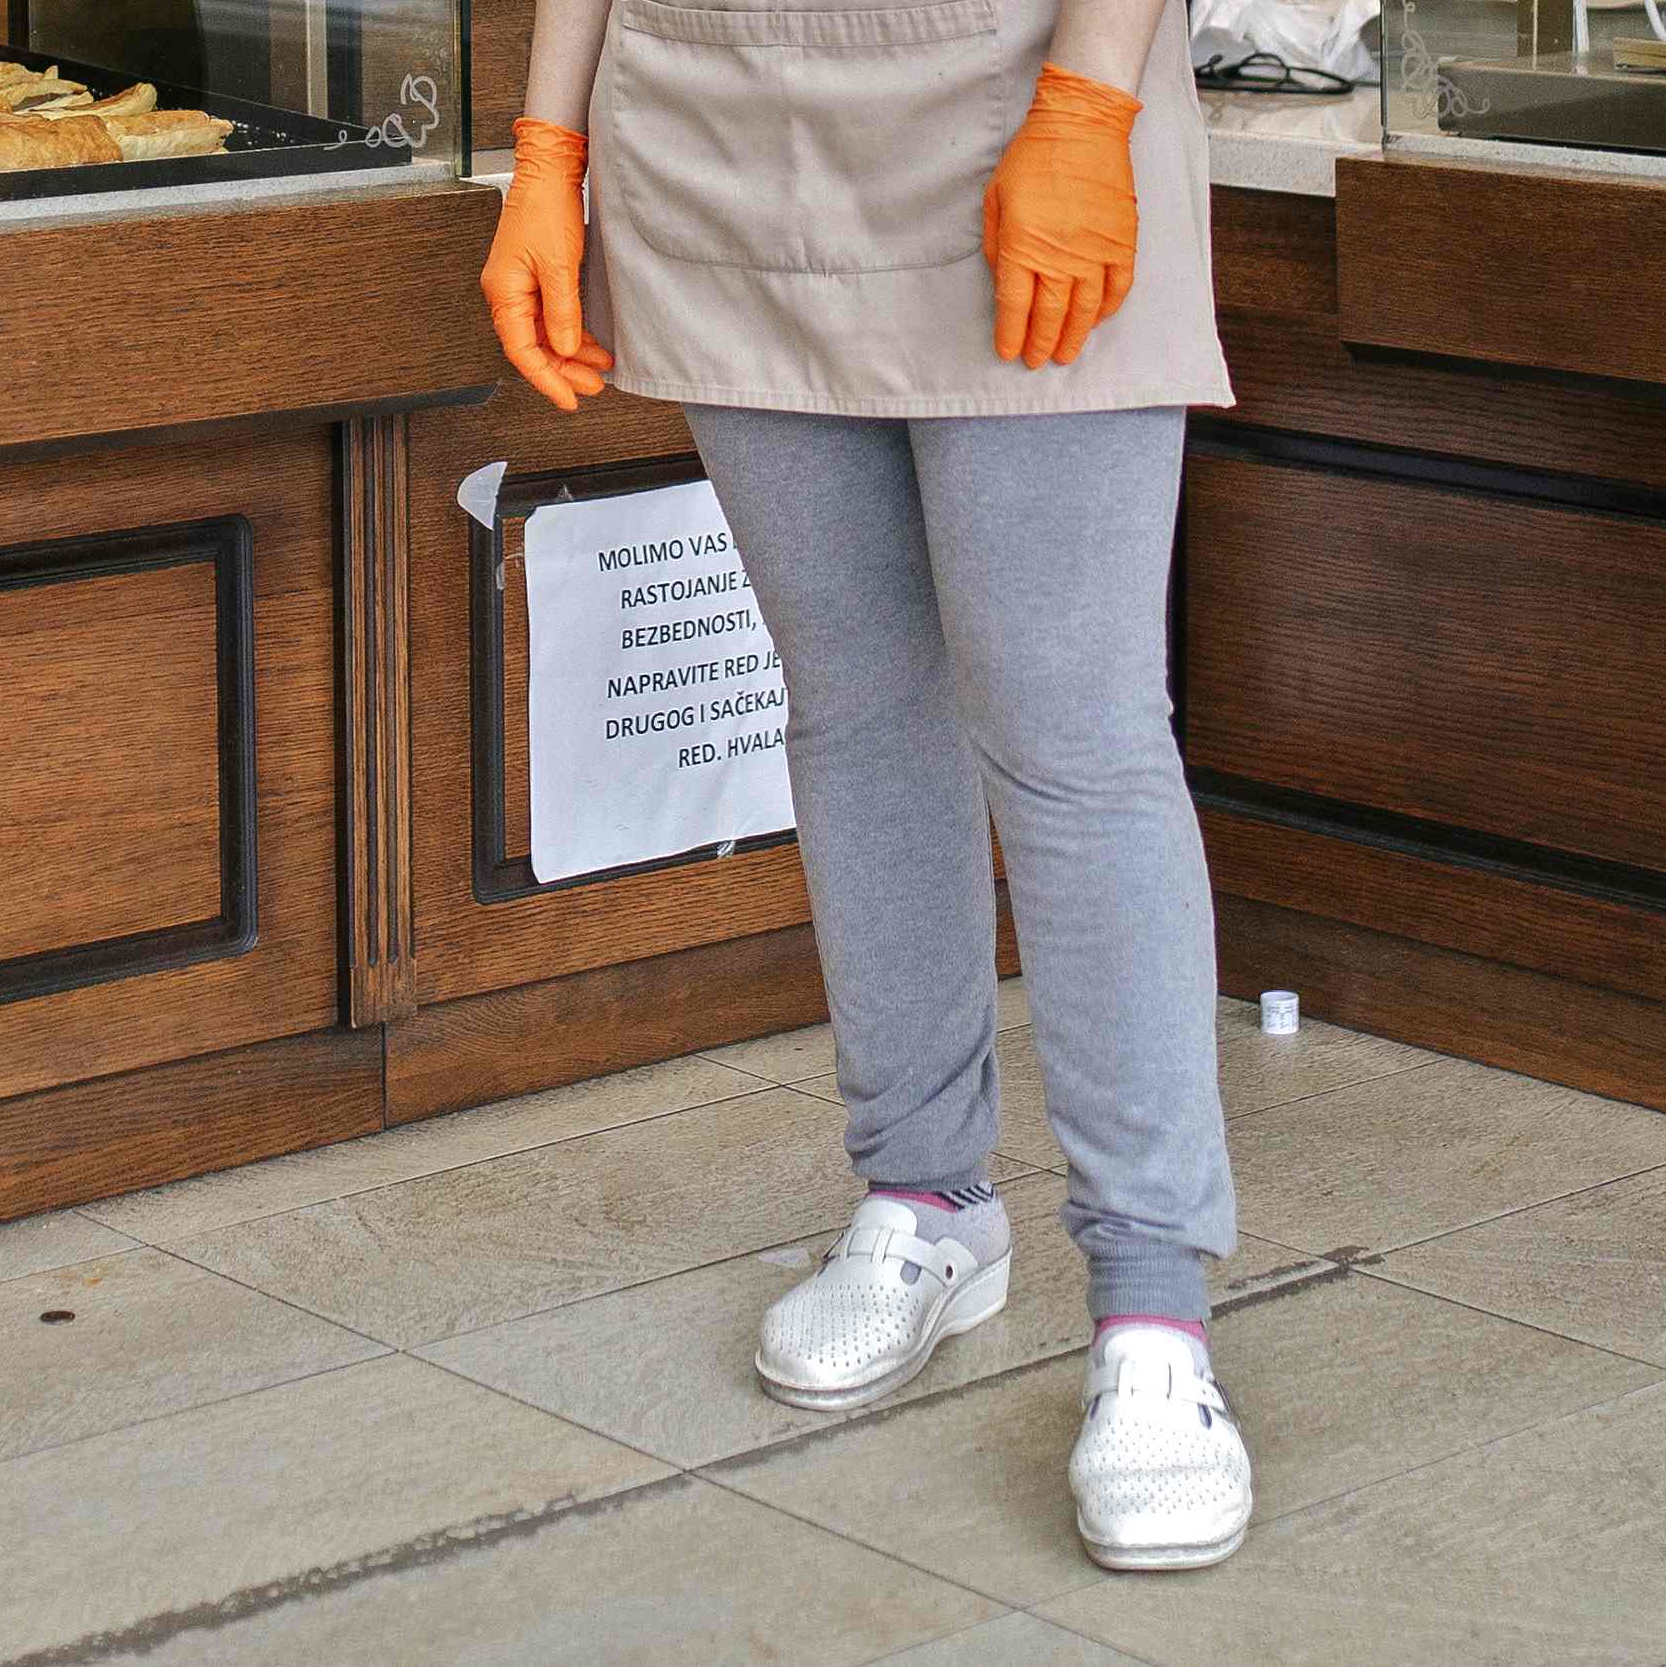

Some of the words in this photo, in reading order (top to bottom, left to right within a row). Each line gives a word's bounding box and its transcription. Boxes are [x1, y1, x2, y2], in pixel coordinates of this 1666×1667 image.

[598, 539, 683, 571] MOLIMO
[688, 532, 727, 556] VAS
[621, 571, 737, 609] RASTOJANJE
[621, 609, 757, 649] BEZBEDNOSTI,
[607, 662, 719, 698] NAPRAVITE
[724, 654, 758, 678] RED
[763, 651, 781, 670] JE
[606, 706, 694, 739] DRUGOG
[700, 704, 705, 723] I
[710, 687, 788, 720] SAČEKAJ
[678, 743, 721, 768] RED.
[727, 728, 785, 758] HVALA
